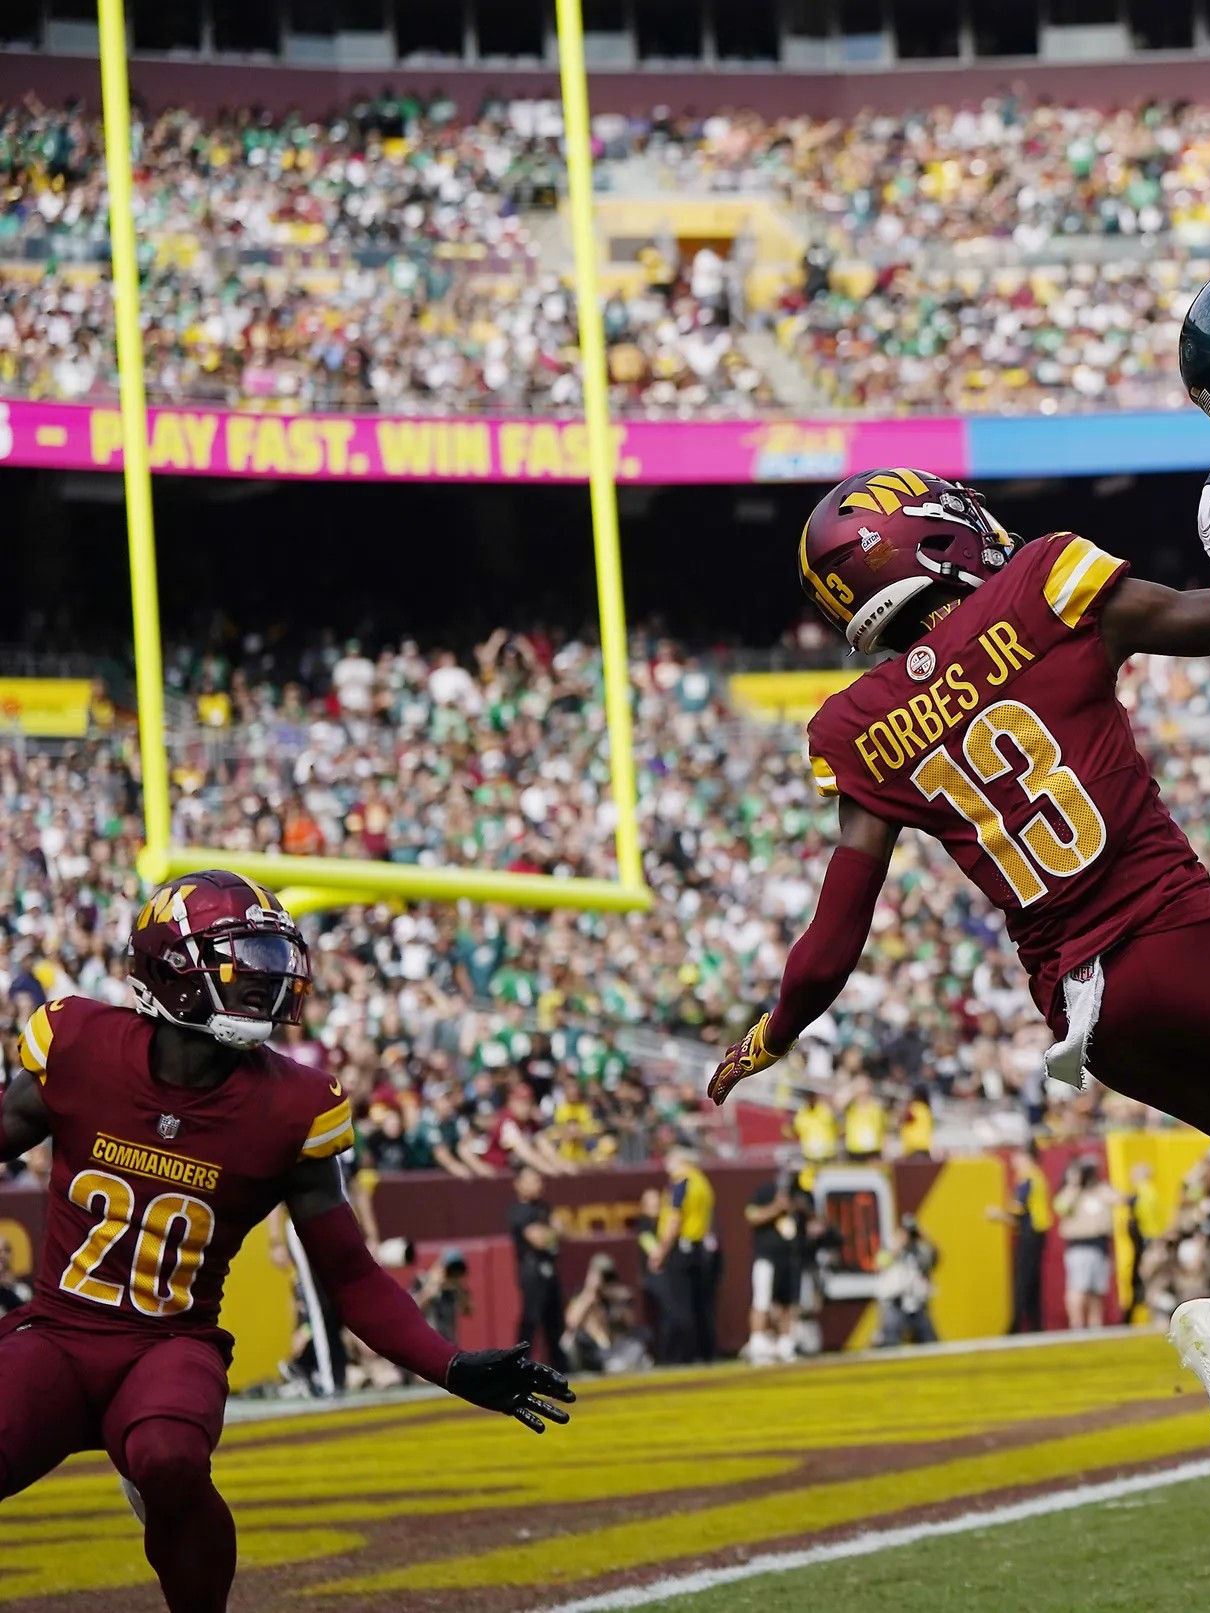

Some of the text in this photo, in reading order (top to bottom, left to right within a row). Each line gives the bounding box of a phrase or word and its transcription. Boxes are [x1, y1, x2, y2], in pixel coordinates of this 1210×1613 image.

[376, 420, 490, 477] WIN
[852, 620, 1036, 784] FORBES JR
[909, 699, 1107, 909] 13
[92, 1137, 220, 1190] COMMANDERS
[58, 1168, 215, 1317] 20
